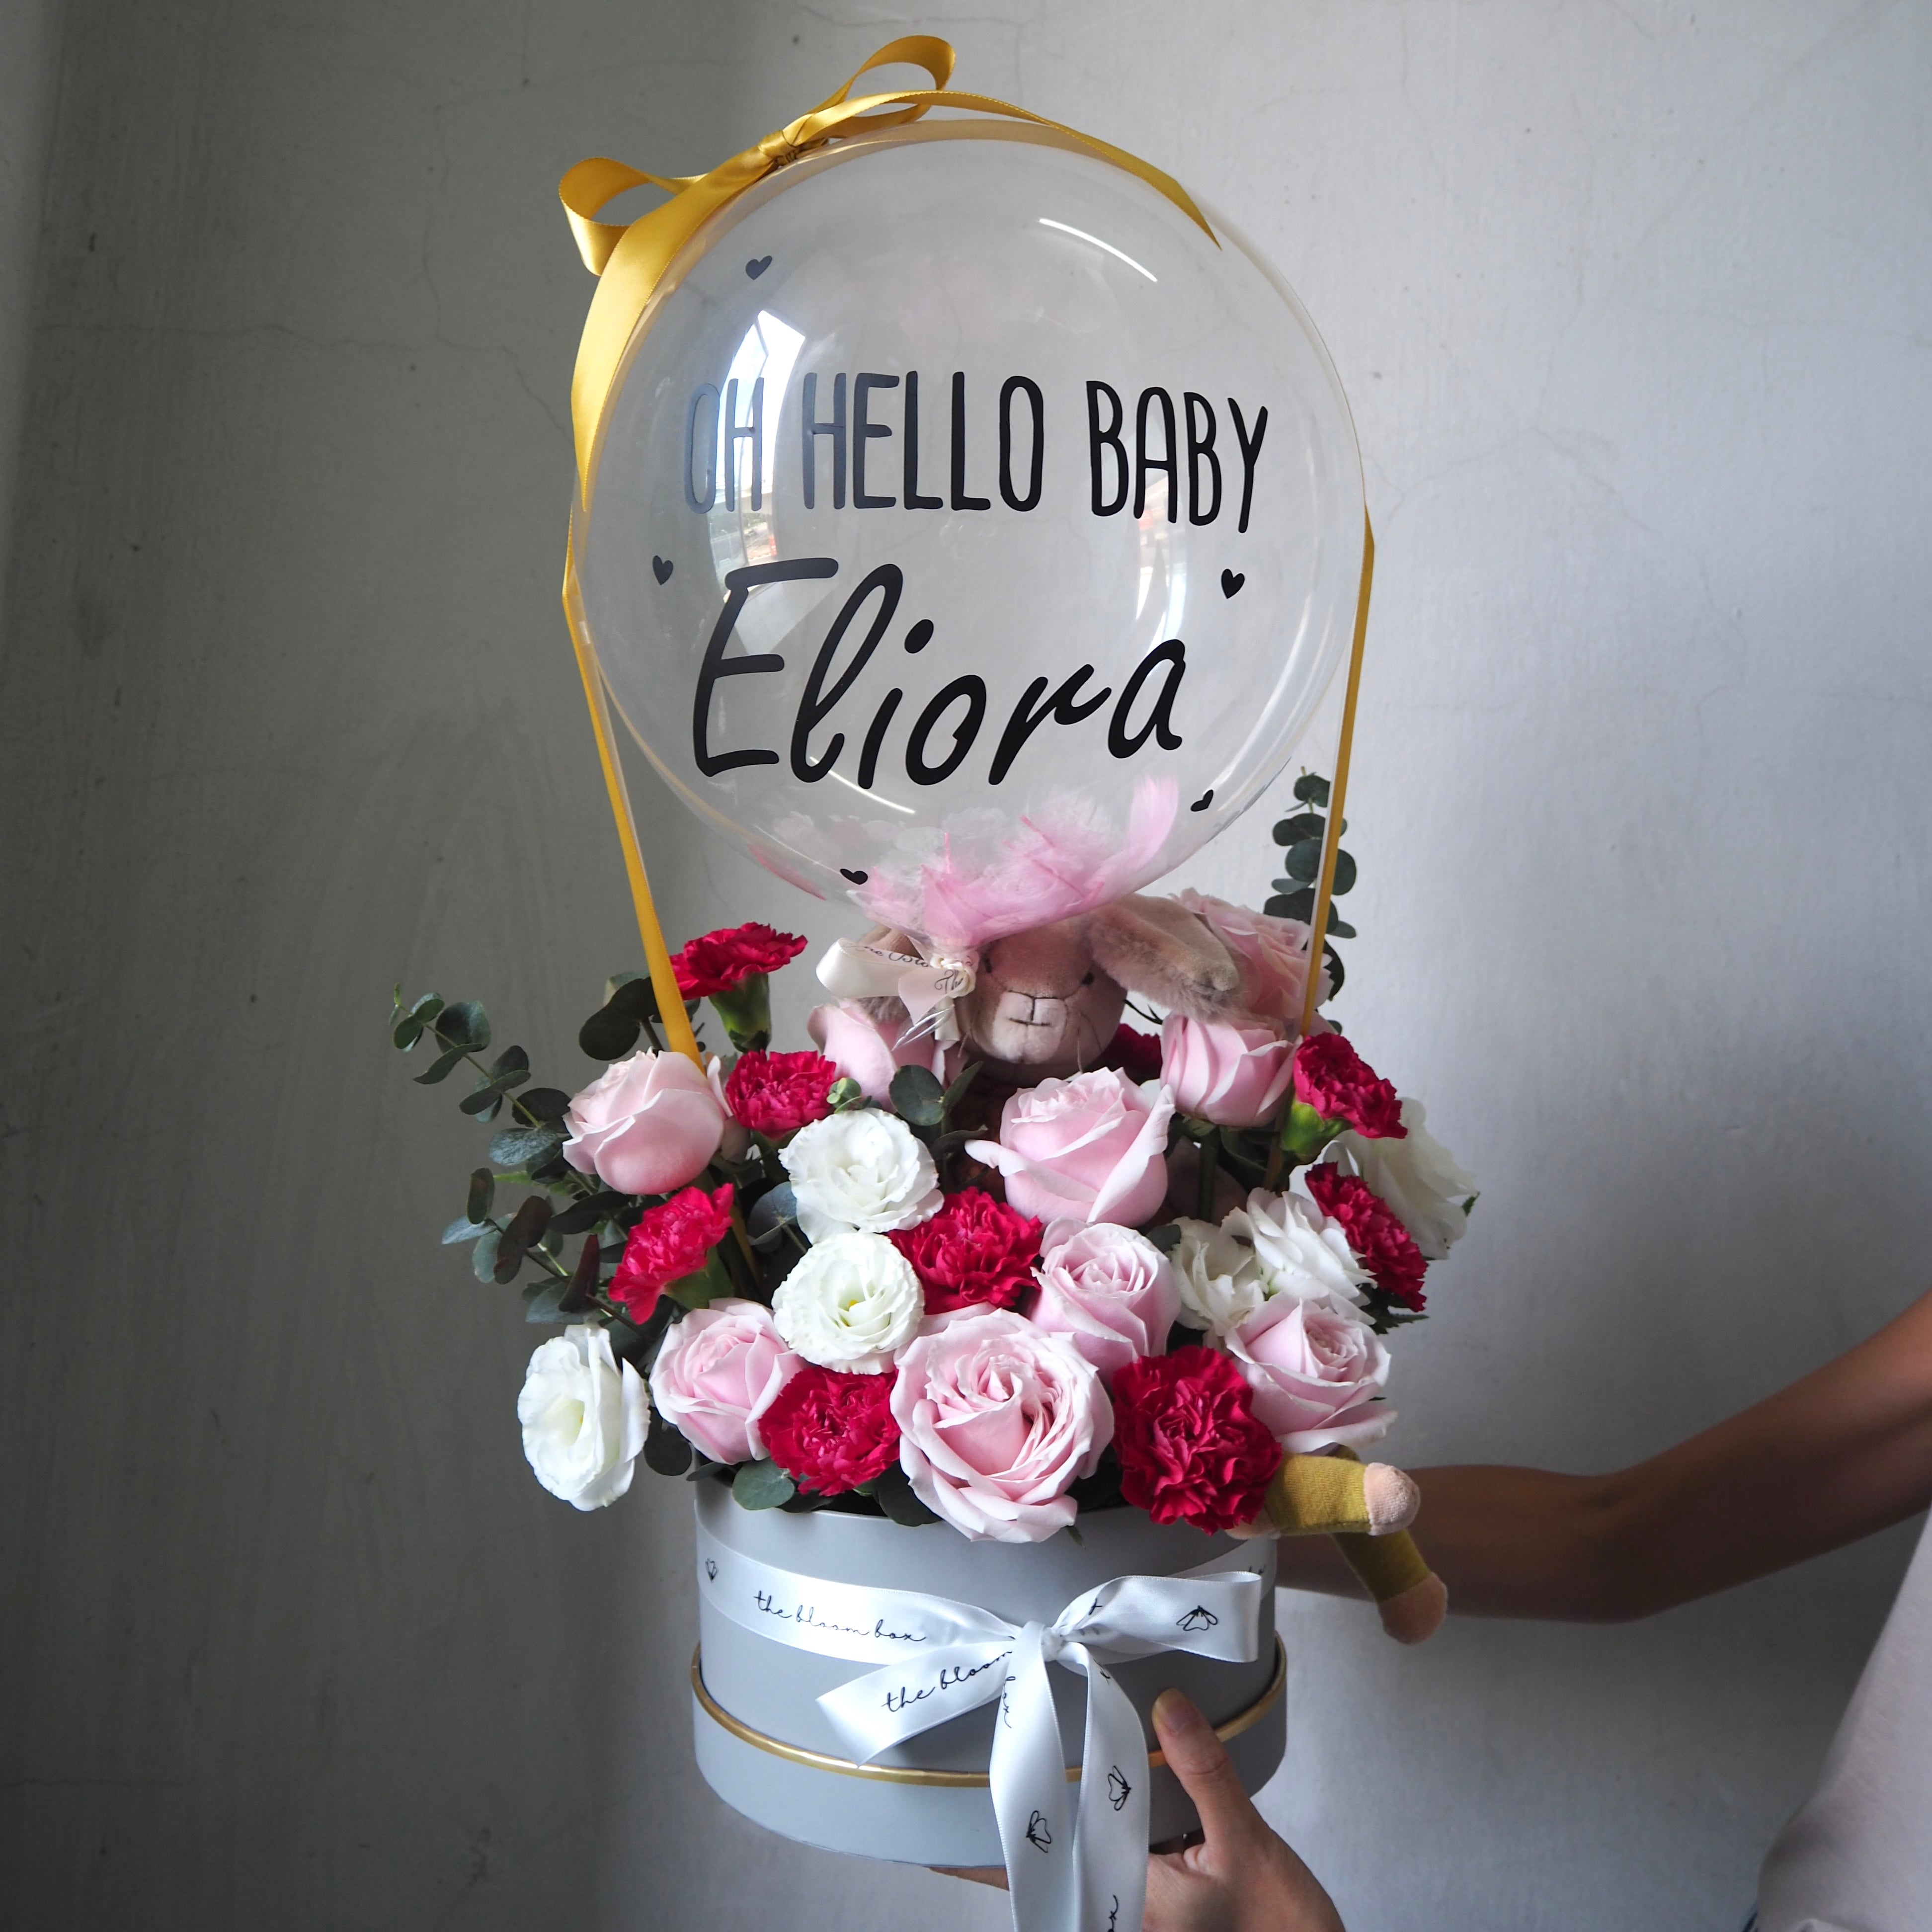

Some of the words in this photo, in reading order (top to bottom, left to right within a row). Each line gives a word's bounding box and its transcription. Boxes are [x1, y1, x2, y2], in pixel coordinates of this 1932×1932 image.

[684, 377, 765, 514] OH
[803, 370, 1044, 512] HELLO
[1086, 380, 1269, 534] BABY
[692, 557, 1186, 790] Eliora
[753, 1590, 793, 1618] the
[796, 1605, 870, 1636] bloom
[874, 1618, 928, 1642] box
[881, 1686, 936, 1712] the
[940, 1651, 1013, 1690] bloom
